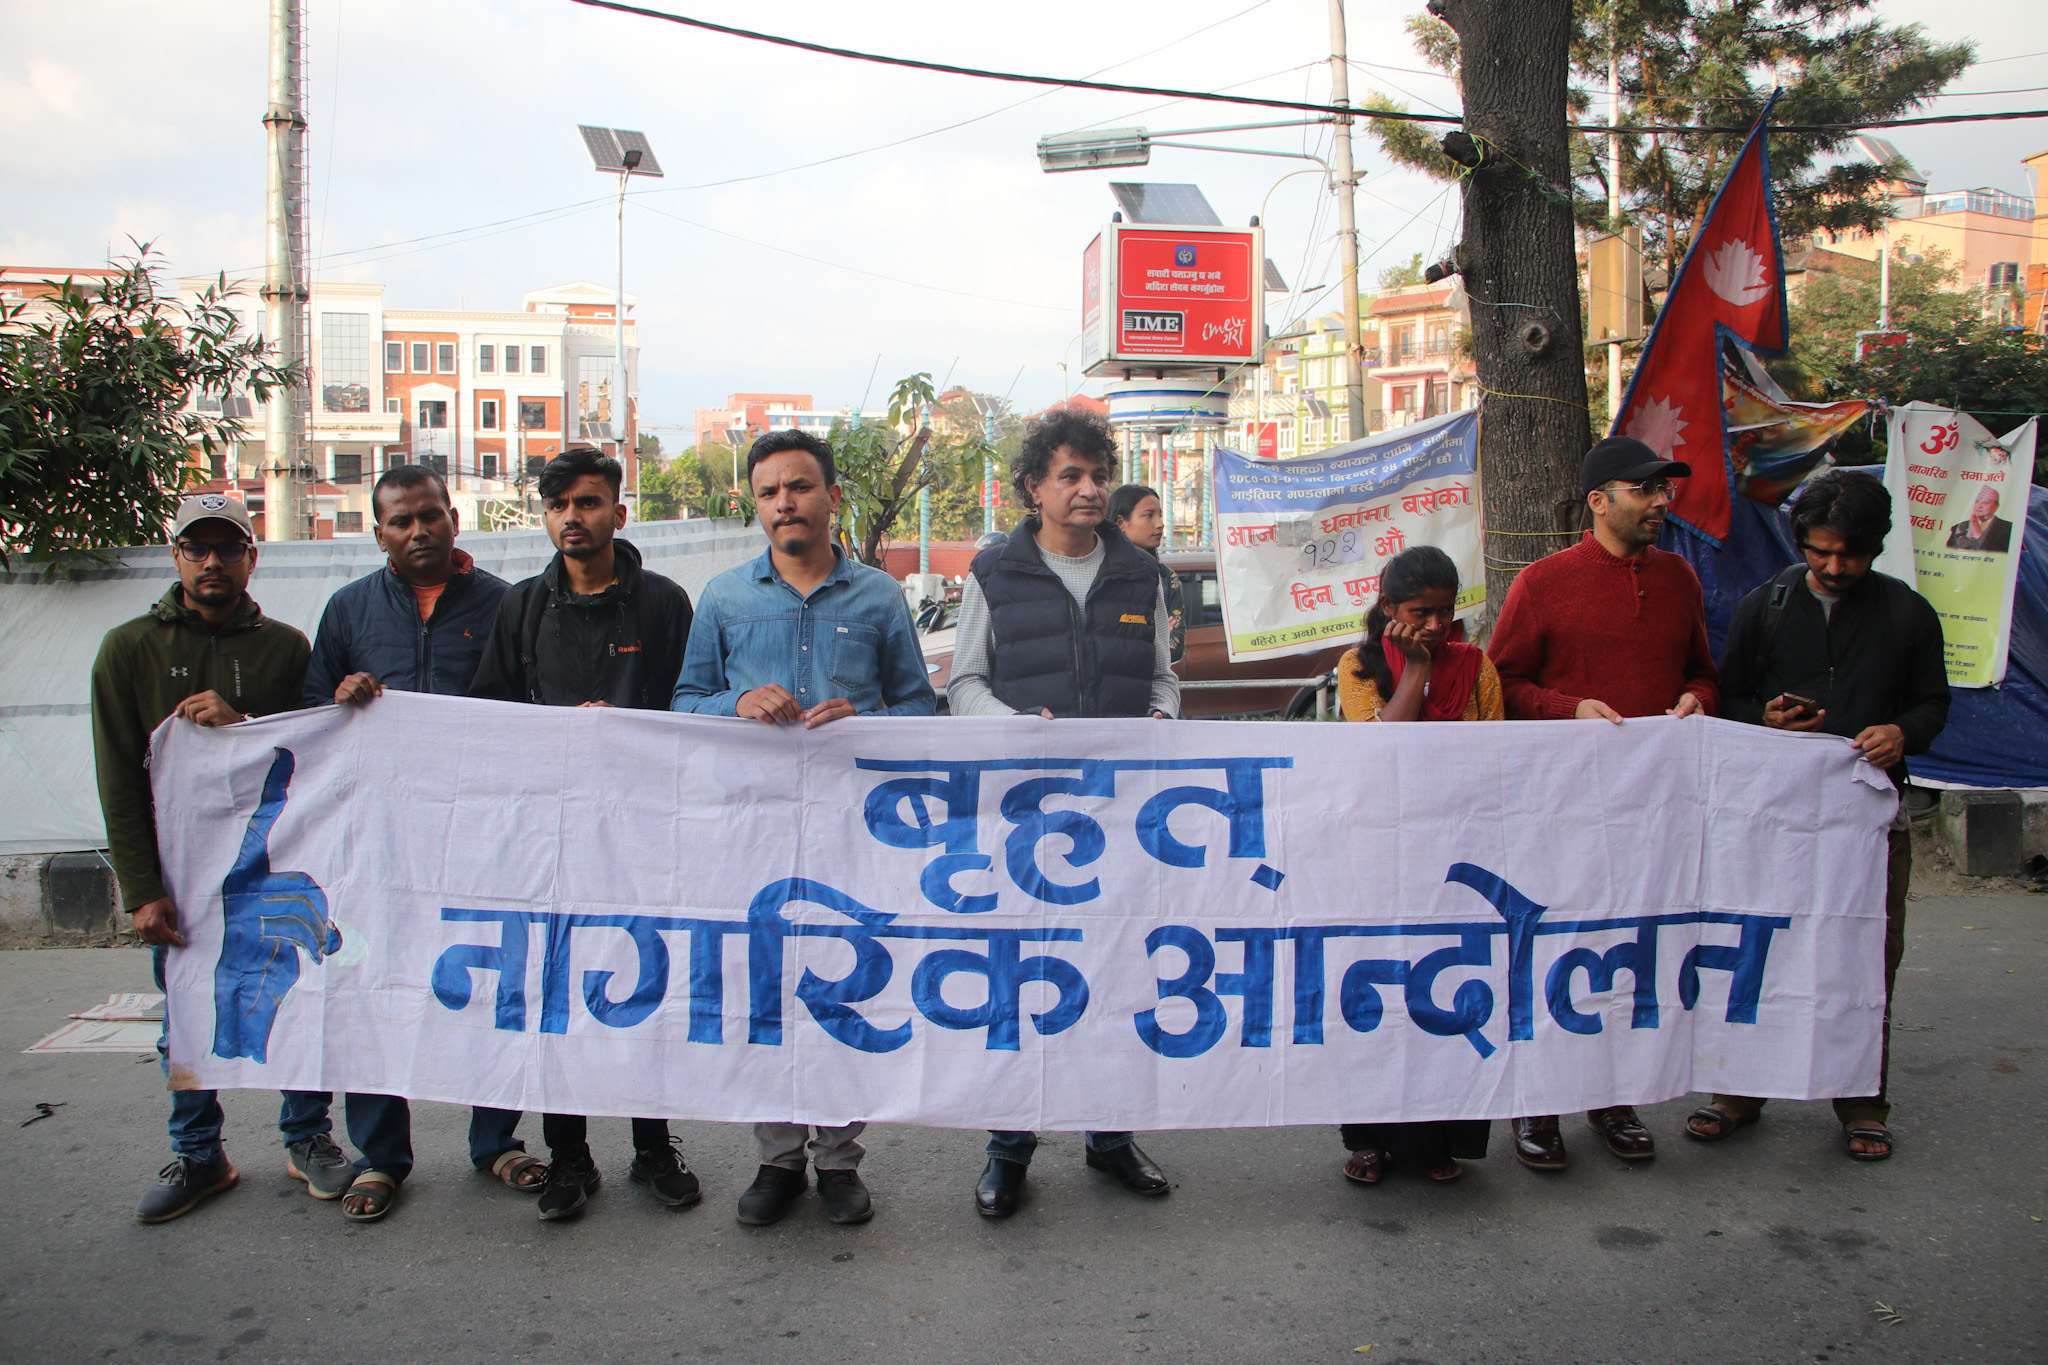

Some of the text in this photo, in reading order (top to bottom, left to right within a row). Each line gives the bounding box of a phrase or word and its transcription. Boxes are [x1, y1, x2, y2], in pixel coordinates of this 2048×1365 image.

[1133, 315, 1179, 332] IME
[1381, 462, 1399, 474] २४
[1908, 463, 2006, 482] नागरिक समाजले
[1226, 481, 1473, 549] आज धर्नामा बसेको
[1290, 570, 1382, 613] दिन पुग्य
[1280, 632, 1288, 642] र
[1321, 620, 1357, 635] सरकार
[432, 862, 1792, 1059] नागरिक आन्दोलन
